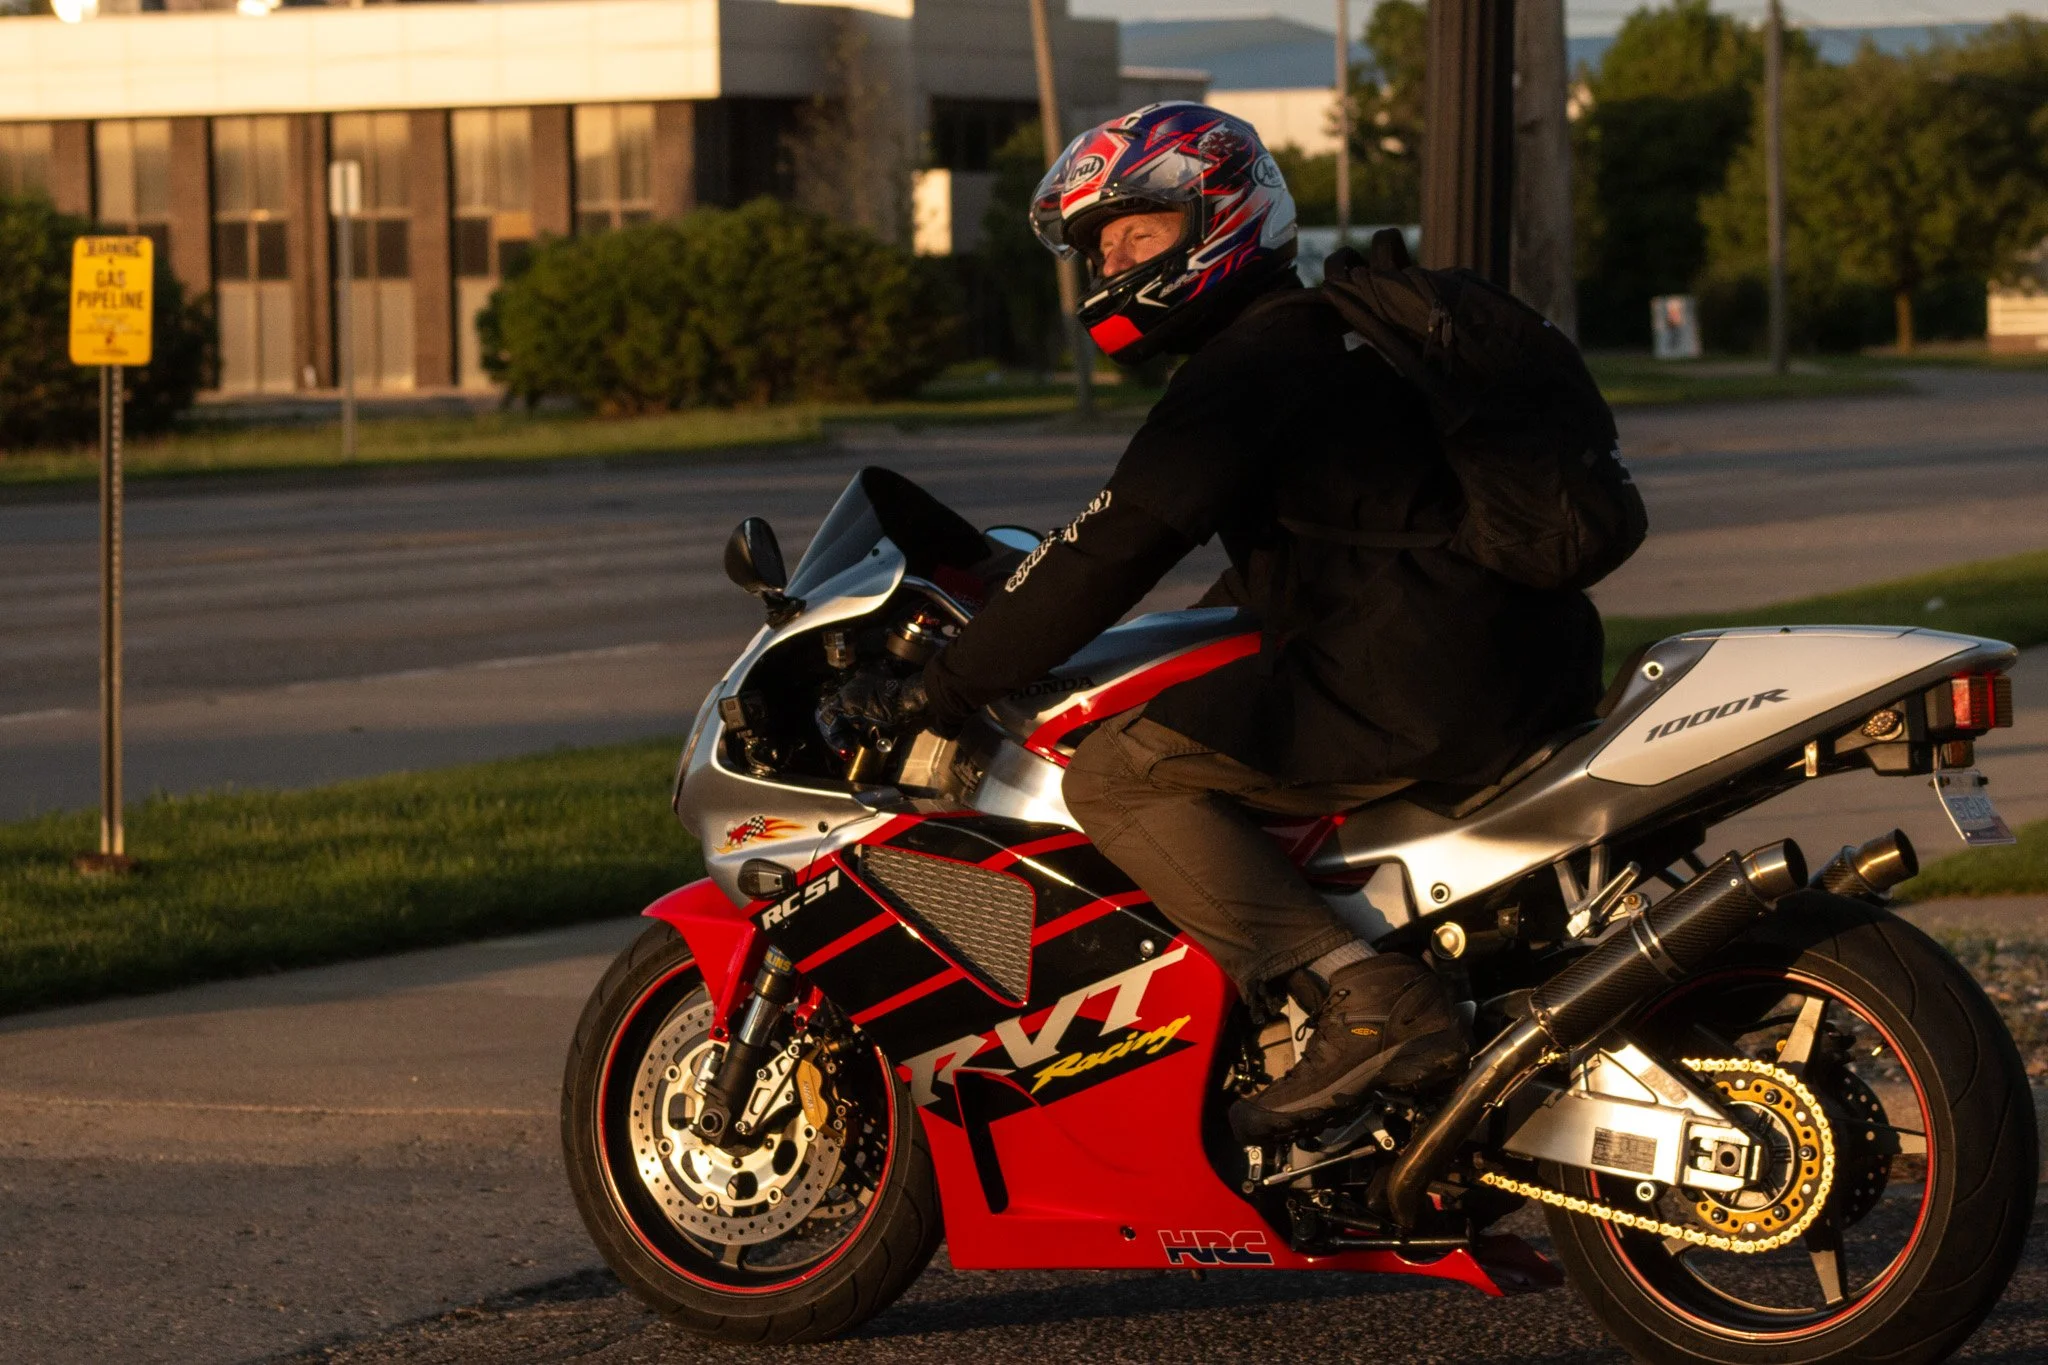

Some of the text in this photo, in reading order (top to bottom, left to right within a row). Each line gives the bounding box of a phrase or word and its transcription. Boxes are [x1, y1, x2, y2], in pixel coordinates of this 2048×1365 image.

[96, 270, 126, 288] GAS
[77, 290, 143, 309] PIPELINE
[1005, 677, 1094, 700] HONDA
[1644, 689, 1790, 743] 1000R
[900, 944, 1189, 1107] RVT
[1350, 1027, 1378, 1036] KEEN
[1030, 1014, 1191, 1095] Racing
[1157, 1229, 1275, 1265] HRC
